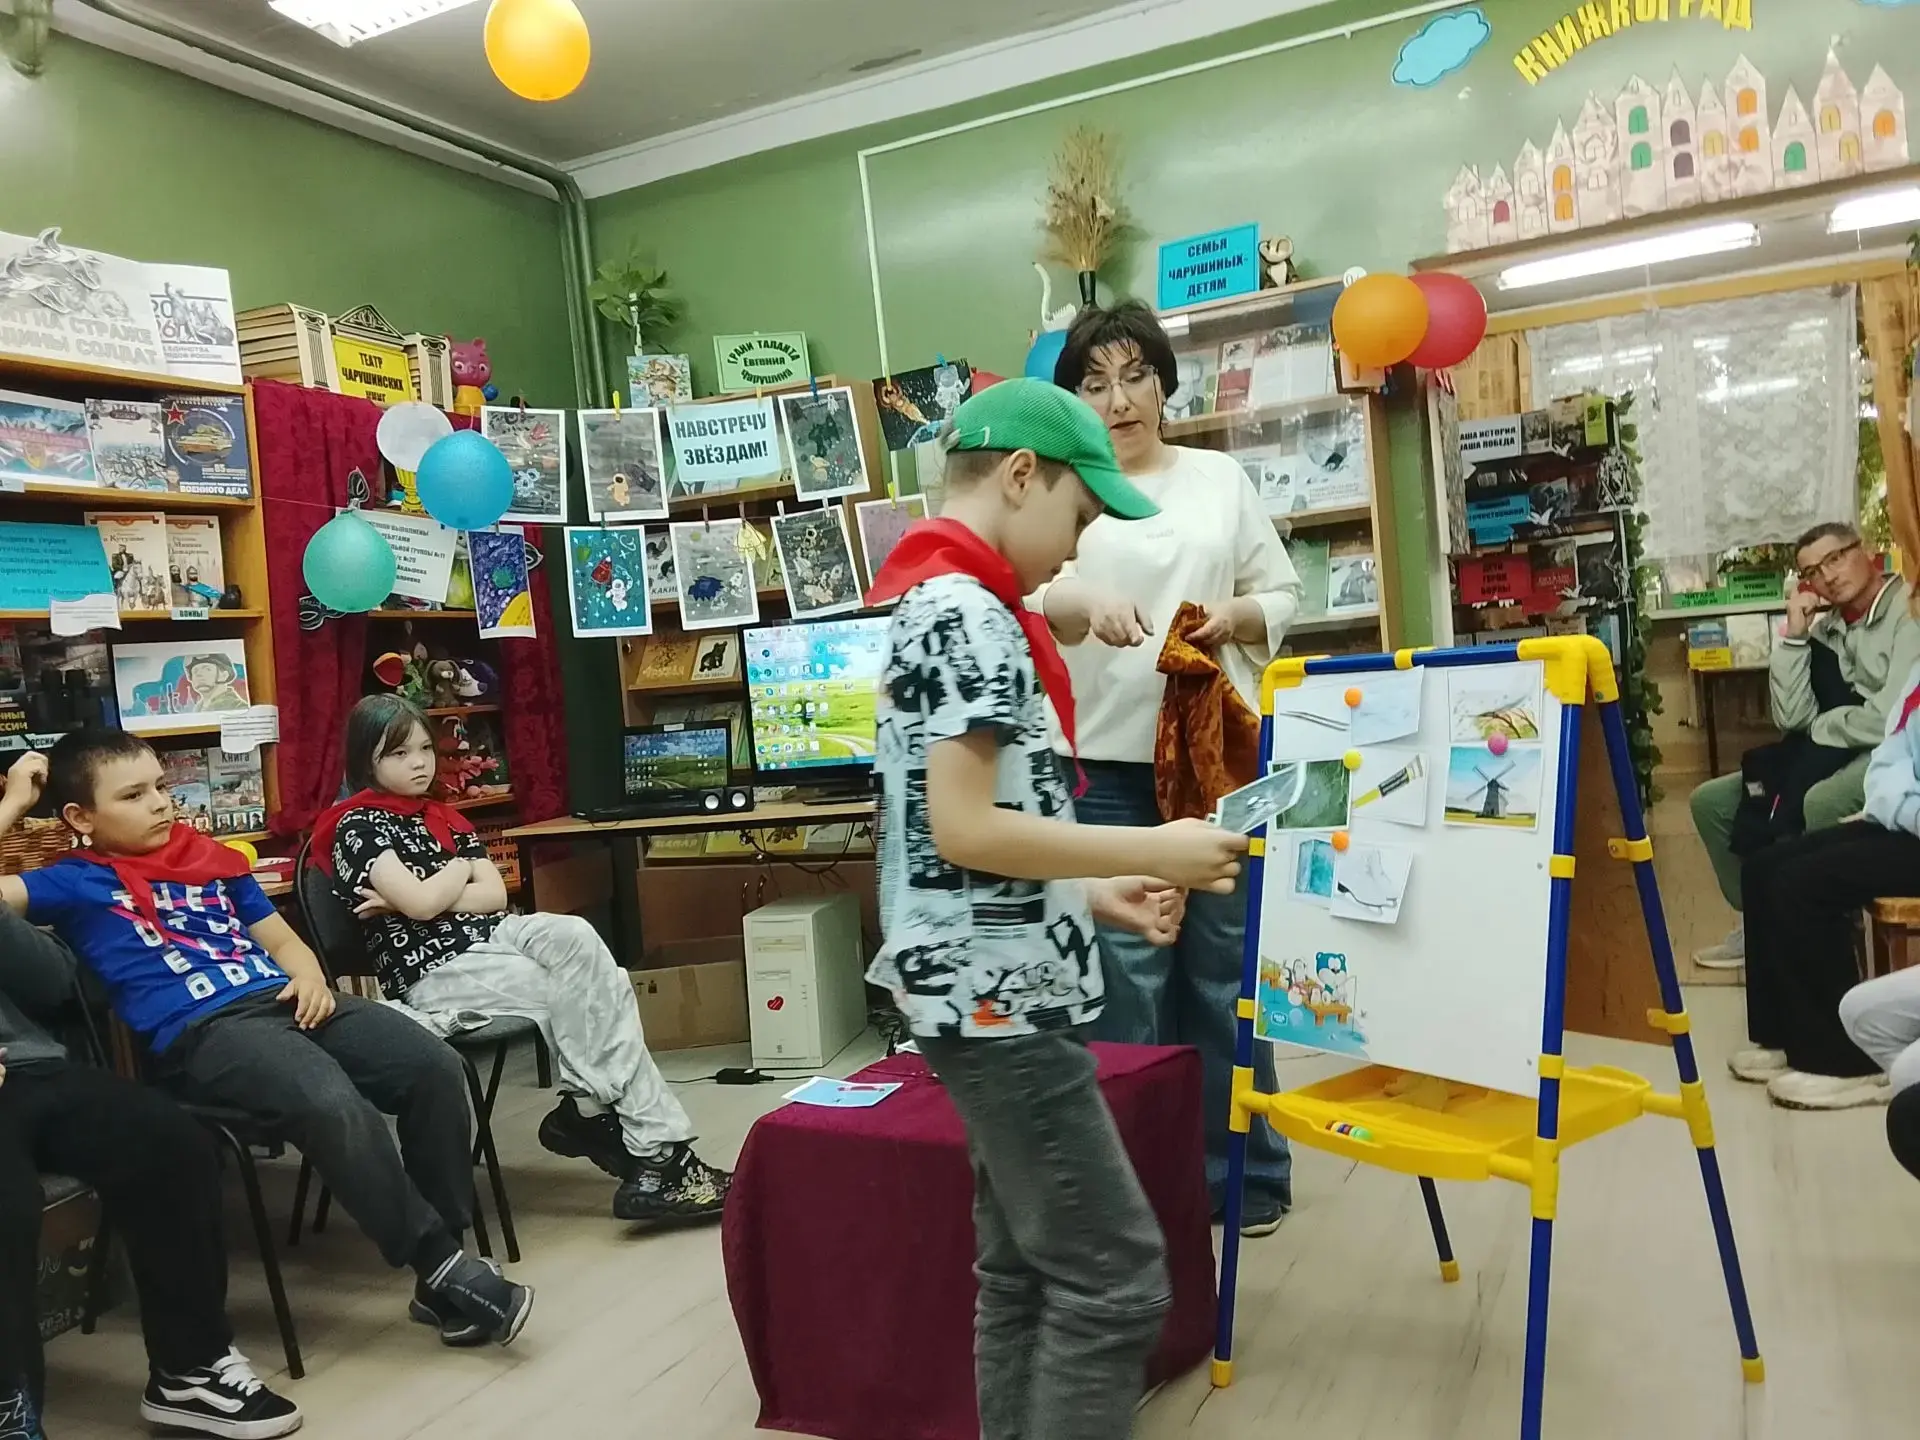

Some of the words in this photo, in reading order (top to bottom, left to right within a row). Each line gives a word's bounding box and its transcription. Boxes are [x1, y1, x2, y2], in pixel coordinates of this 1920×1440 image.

[1187, 238, 1227, 258] СЕМЬЯ
[1186, 277, 1227, 300] ДЕТЯМ
[69, 317, 154, 346] СТРАЖЕ
[76, 338, 158, 365] СОЛДАТ
[359, 352, 384, 369] ТЕАТР
[727, 341, 754, 365] ГРАНИ
[756, 340, 801, 362] ТАЛАНТА
[341, 367, 404, 392] ЧАРУШИНСКИХ
[674, 412, 767, 439] НАВСТРЕЧУ
[684, 440, 768, 467] ЗВЁЗДАМ!
